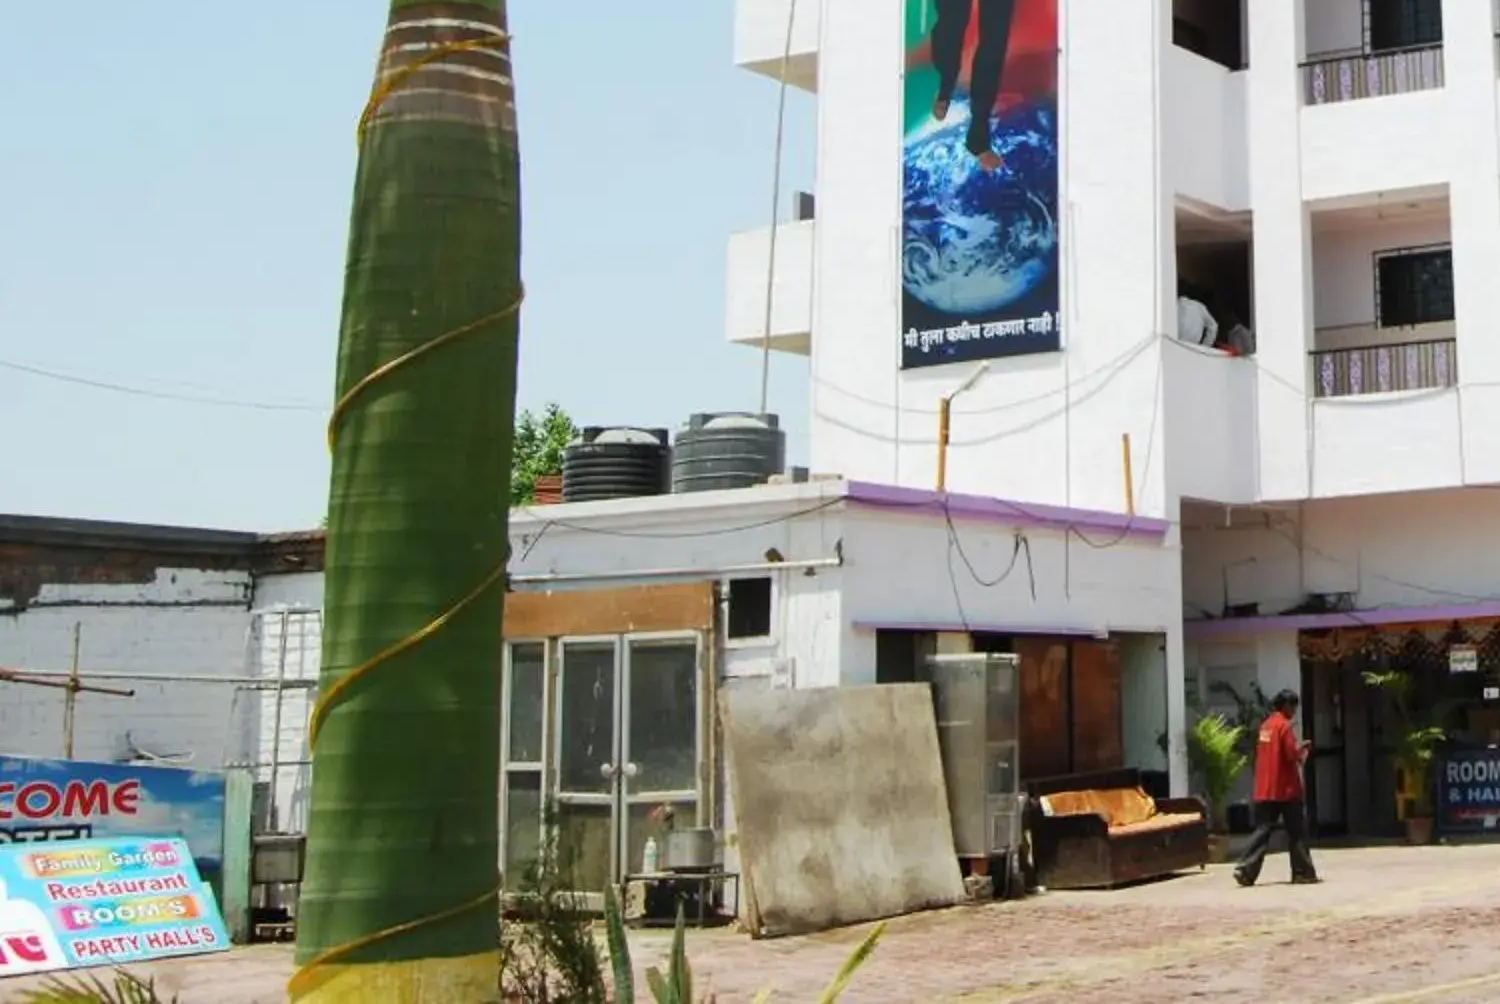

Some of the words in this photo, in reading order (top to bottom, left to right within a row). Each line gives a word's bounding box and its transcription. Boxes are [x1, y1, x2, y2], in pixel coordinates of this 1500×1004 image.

[35, 851, 102, 873] Family
[108, 848, 178, 867] Garden
[47, 873, 188, 900] Restaurant
[73, 899, 187, 926] ROOM'S
[73, 936, 140, 958] PARTY
[146, 927, 216, 949] HALL'S
